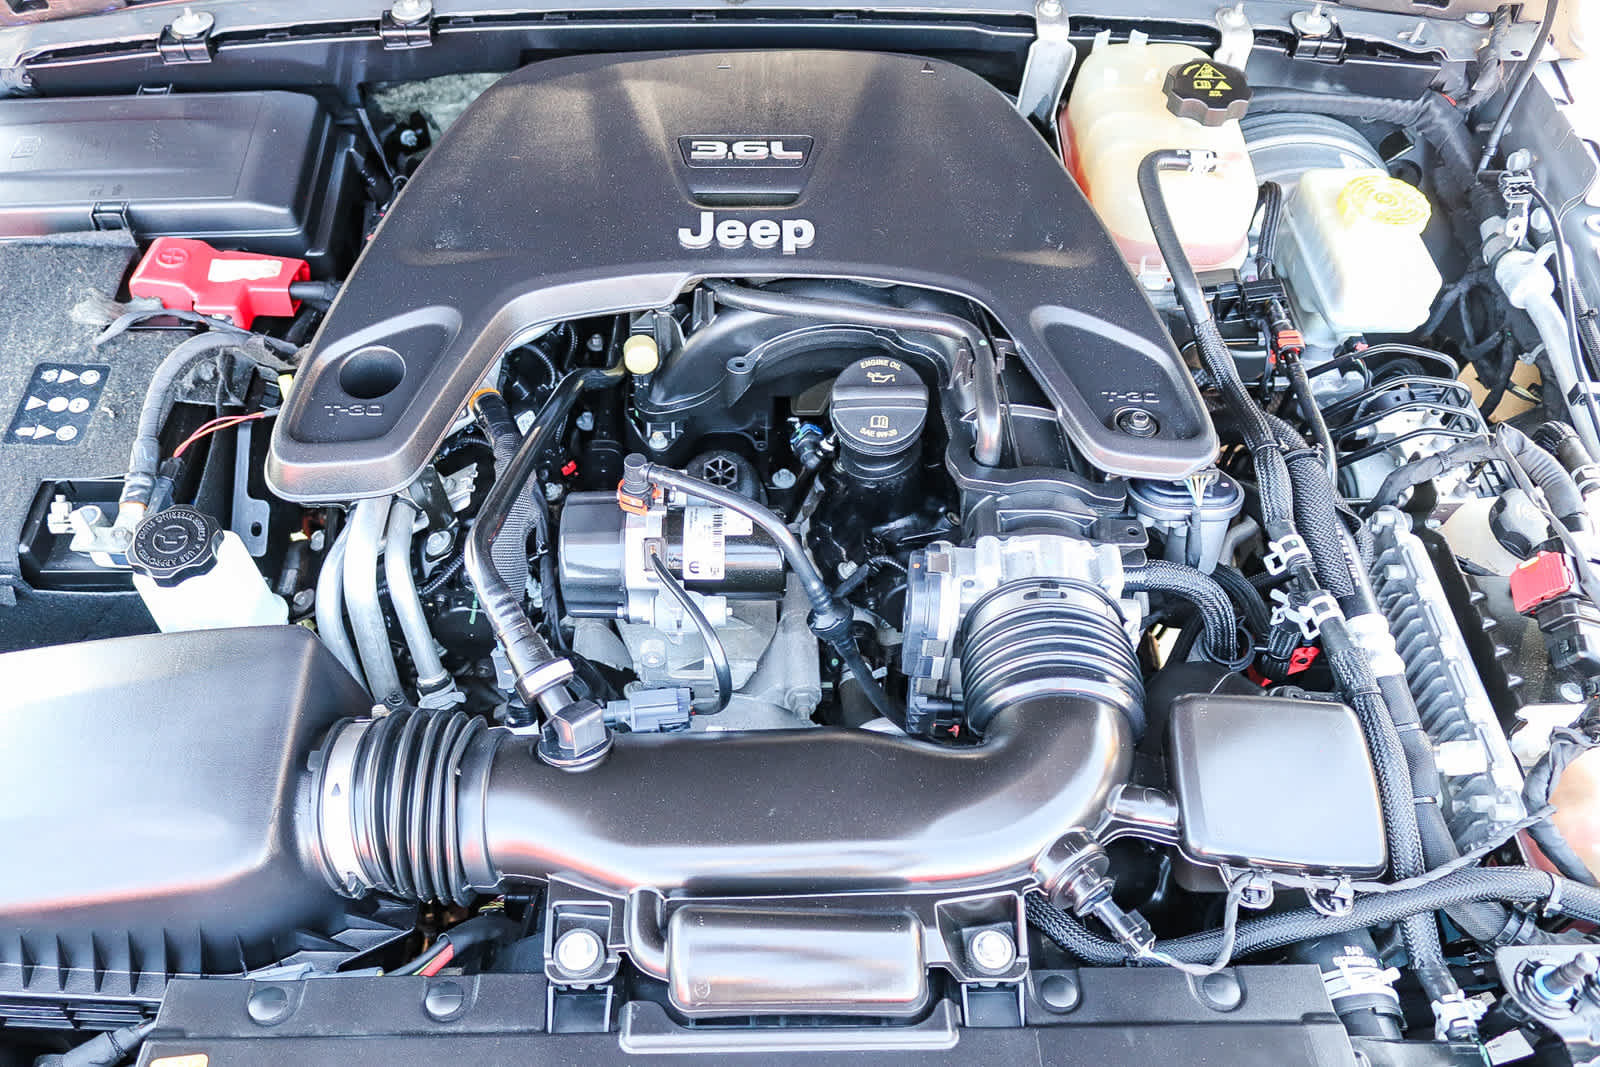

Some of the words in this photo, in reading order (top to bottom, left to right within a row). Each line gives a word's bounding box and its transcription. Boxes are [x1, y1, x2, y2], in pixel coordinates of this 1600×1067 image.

[690, 140, 803, 160] 3.6L
[678, 211, 815, 255] Jeep
[860, 359, 888, 368] ENGINE
[889, 360, 902, 370] OIL
